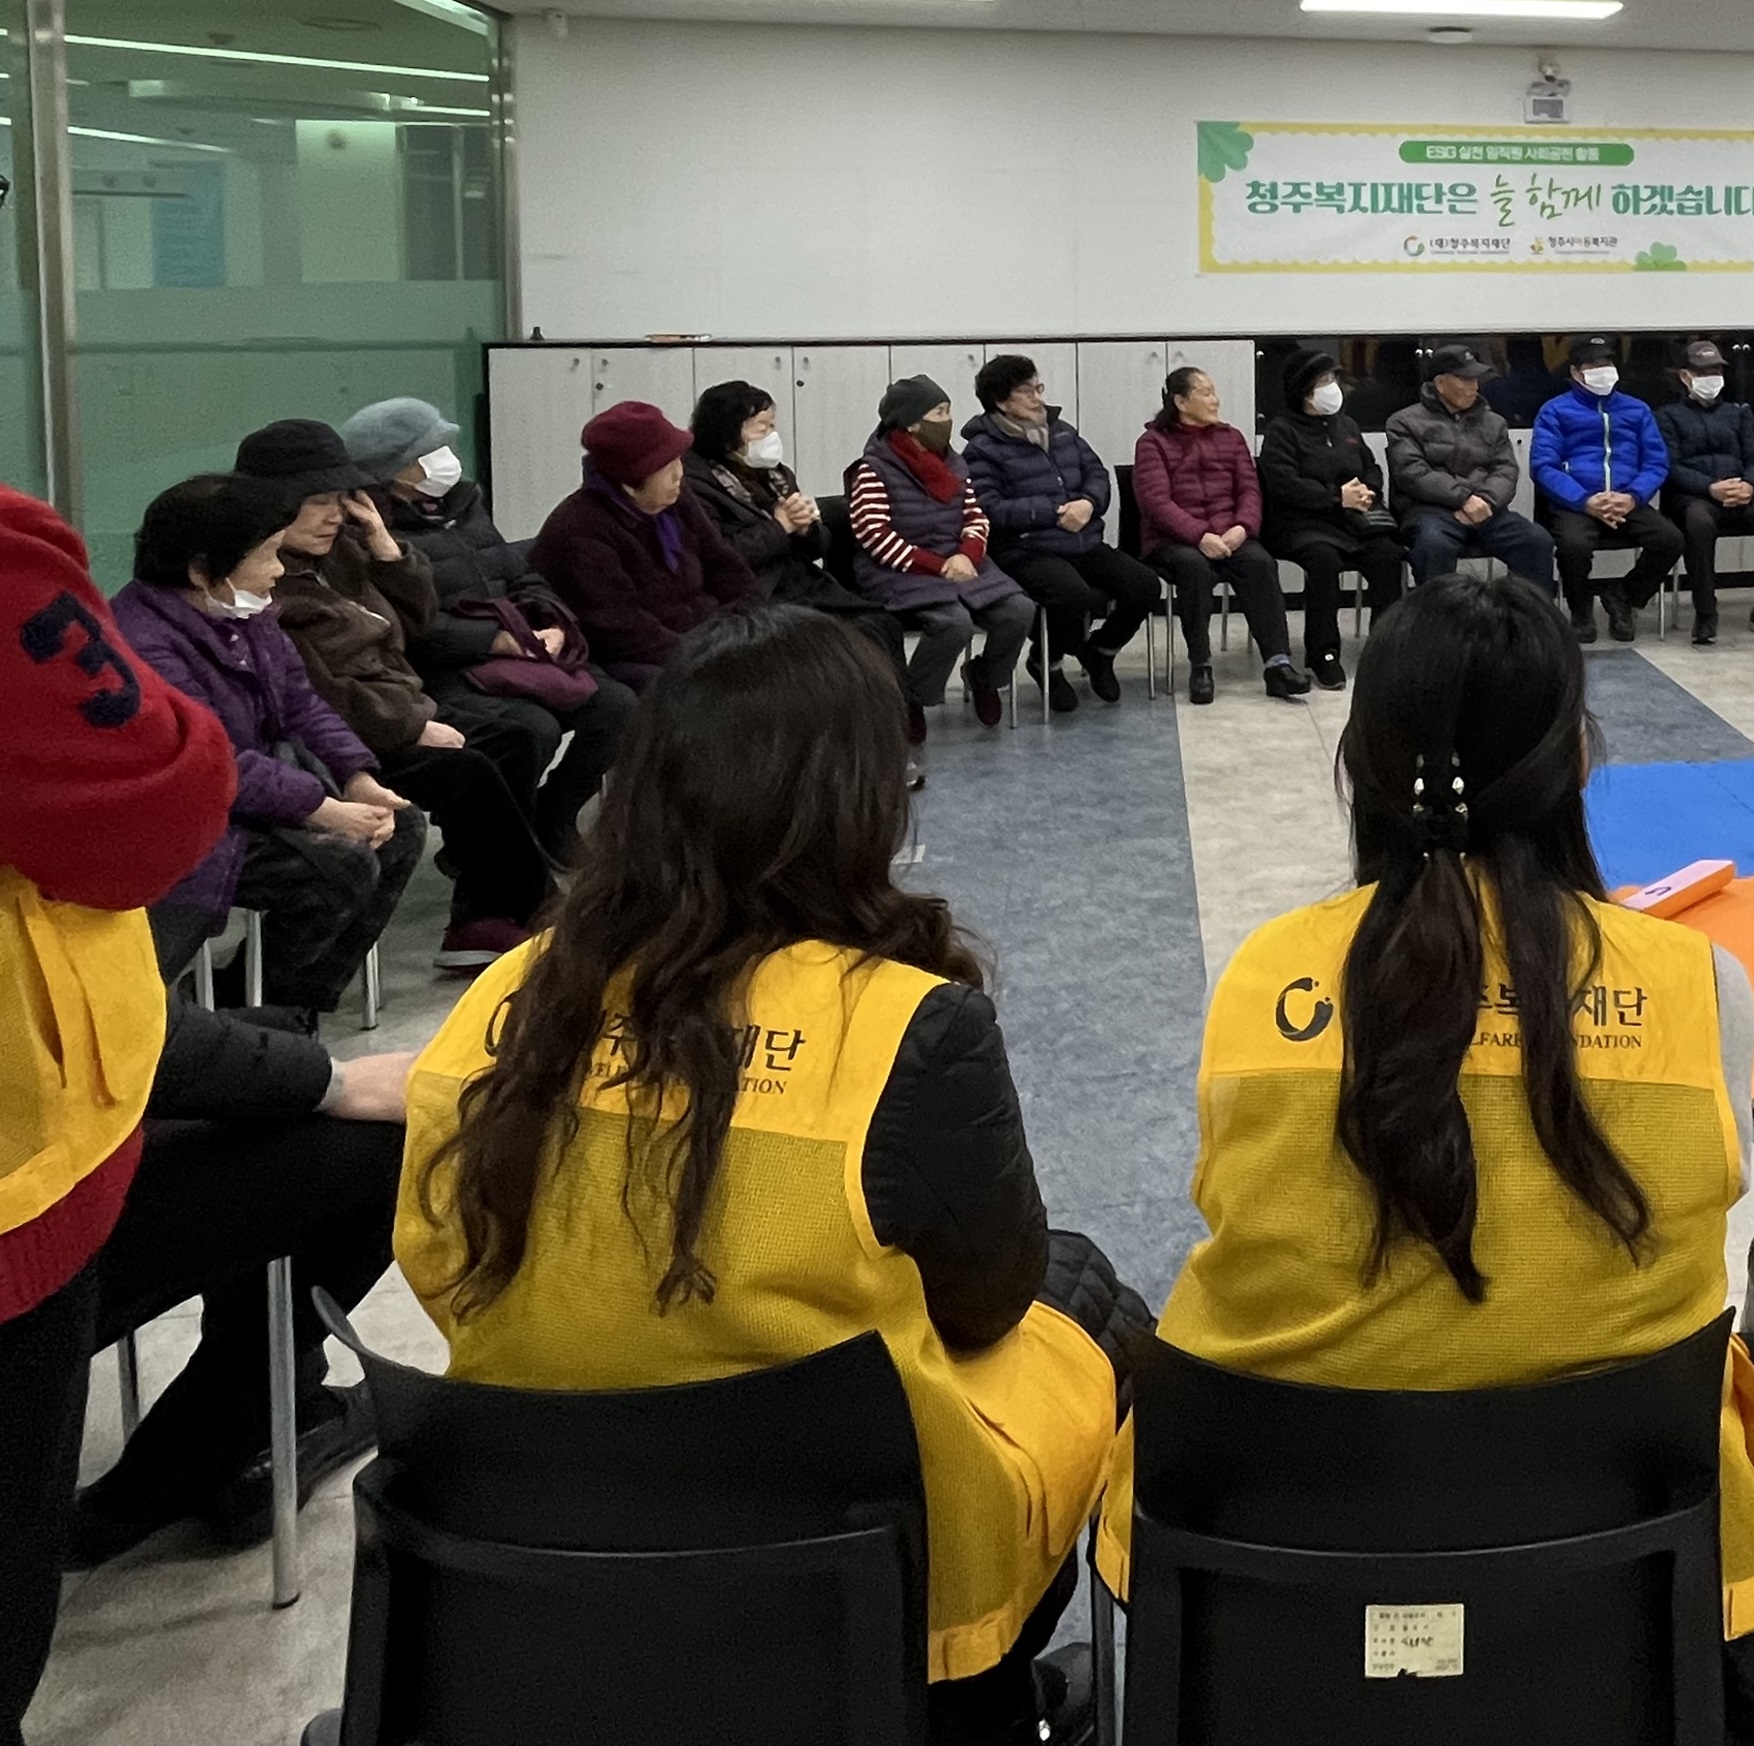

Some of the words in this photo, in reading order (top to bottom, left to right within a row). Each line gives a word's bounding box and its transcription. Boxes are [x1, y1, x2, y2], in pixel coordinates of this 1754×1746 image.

[1426, 145, 1456, 159] ESG
[1245, 181, 1479, 214] 청주복지재단은
[1490, 173, 1516, 228] 늘
[1525, 173, 1602, 220] 함께
[20, 590, 141, 729] 3
